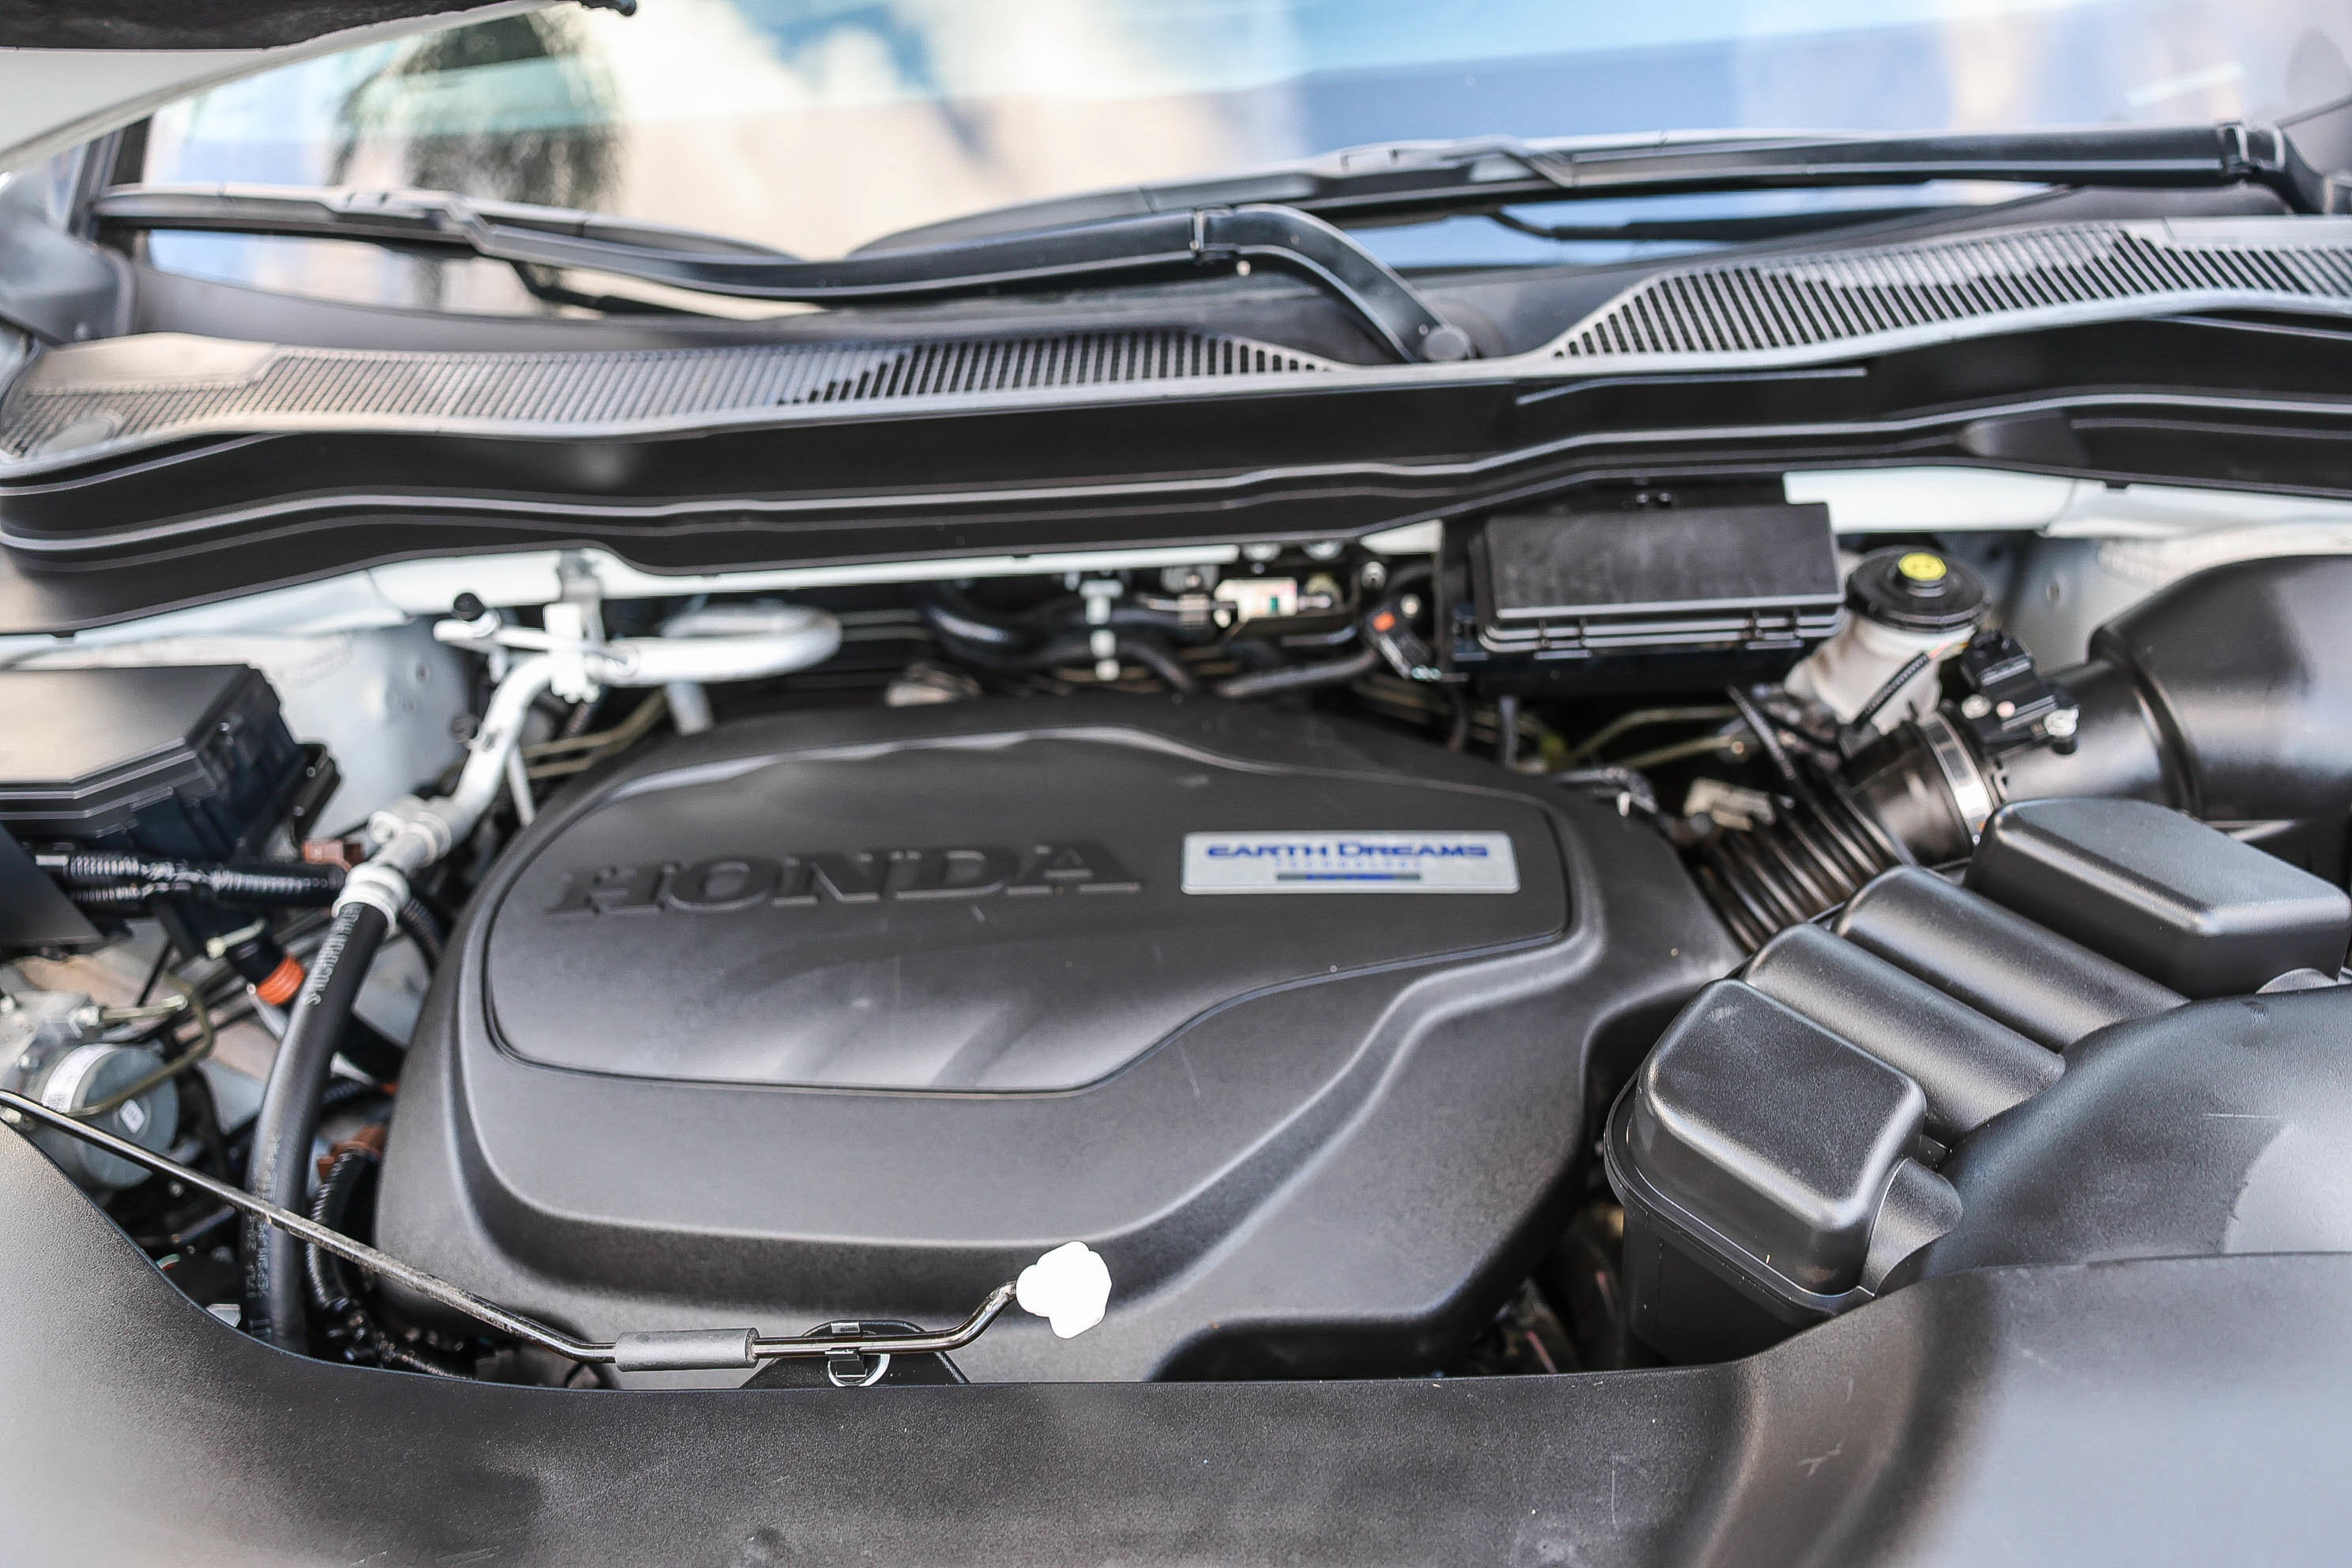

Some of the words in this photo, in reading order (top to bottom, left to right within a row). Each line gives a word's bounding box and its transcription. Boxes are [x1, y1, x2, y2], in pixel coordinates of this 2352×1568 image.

[1208, 843, 1329, 858] EARTH
[1338, 842, 1489, 858] DREAMS
[548, 841, 1144, 915] HONDA
